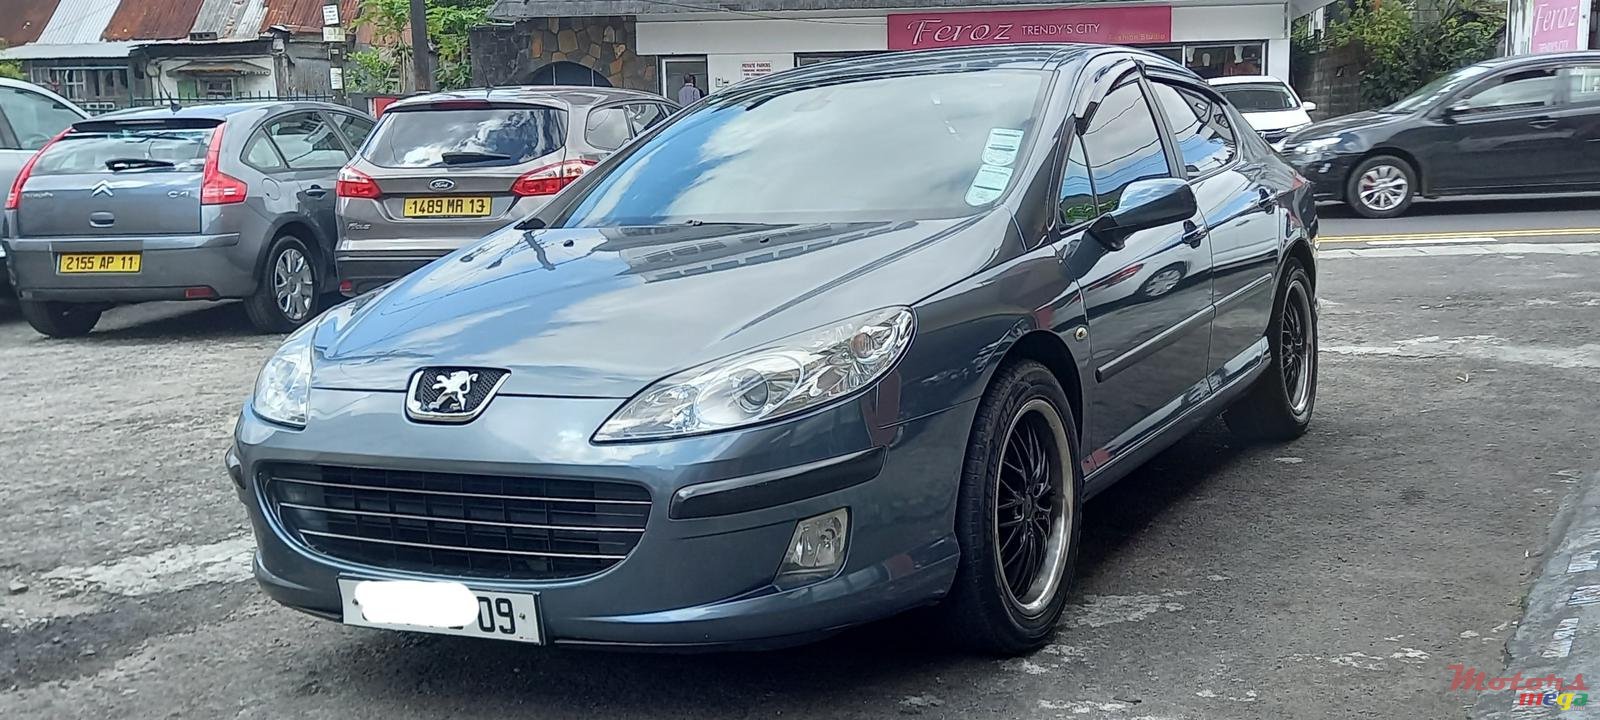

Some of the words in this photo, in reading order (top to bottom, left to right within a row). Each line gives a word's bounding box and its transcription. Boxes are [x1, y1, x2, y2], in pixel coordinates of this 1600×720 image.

[1534, 4, 1578, 37] Feroz
[906, 19, 1015, 46] Feroz
[1021, 24, 1073, 36] TRENDY'S
[1076, 23, 1101, 34] CITY
[434, 181, 449, 189] Ford
[167, 190, 190, 198] C4
[412, 200, 443, 214] 1489
[469, 199, 484, 213] 13
[67, 256, 95, 270] 2155
[99, 256, 114, 270] AP
[121, 256, 134, 269] 11
[477, 596, 516, 635] 09
